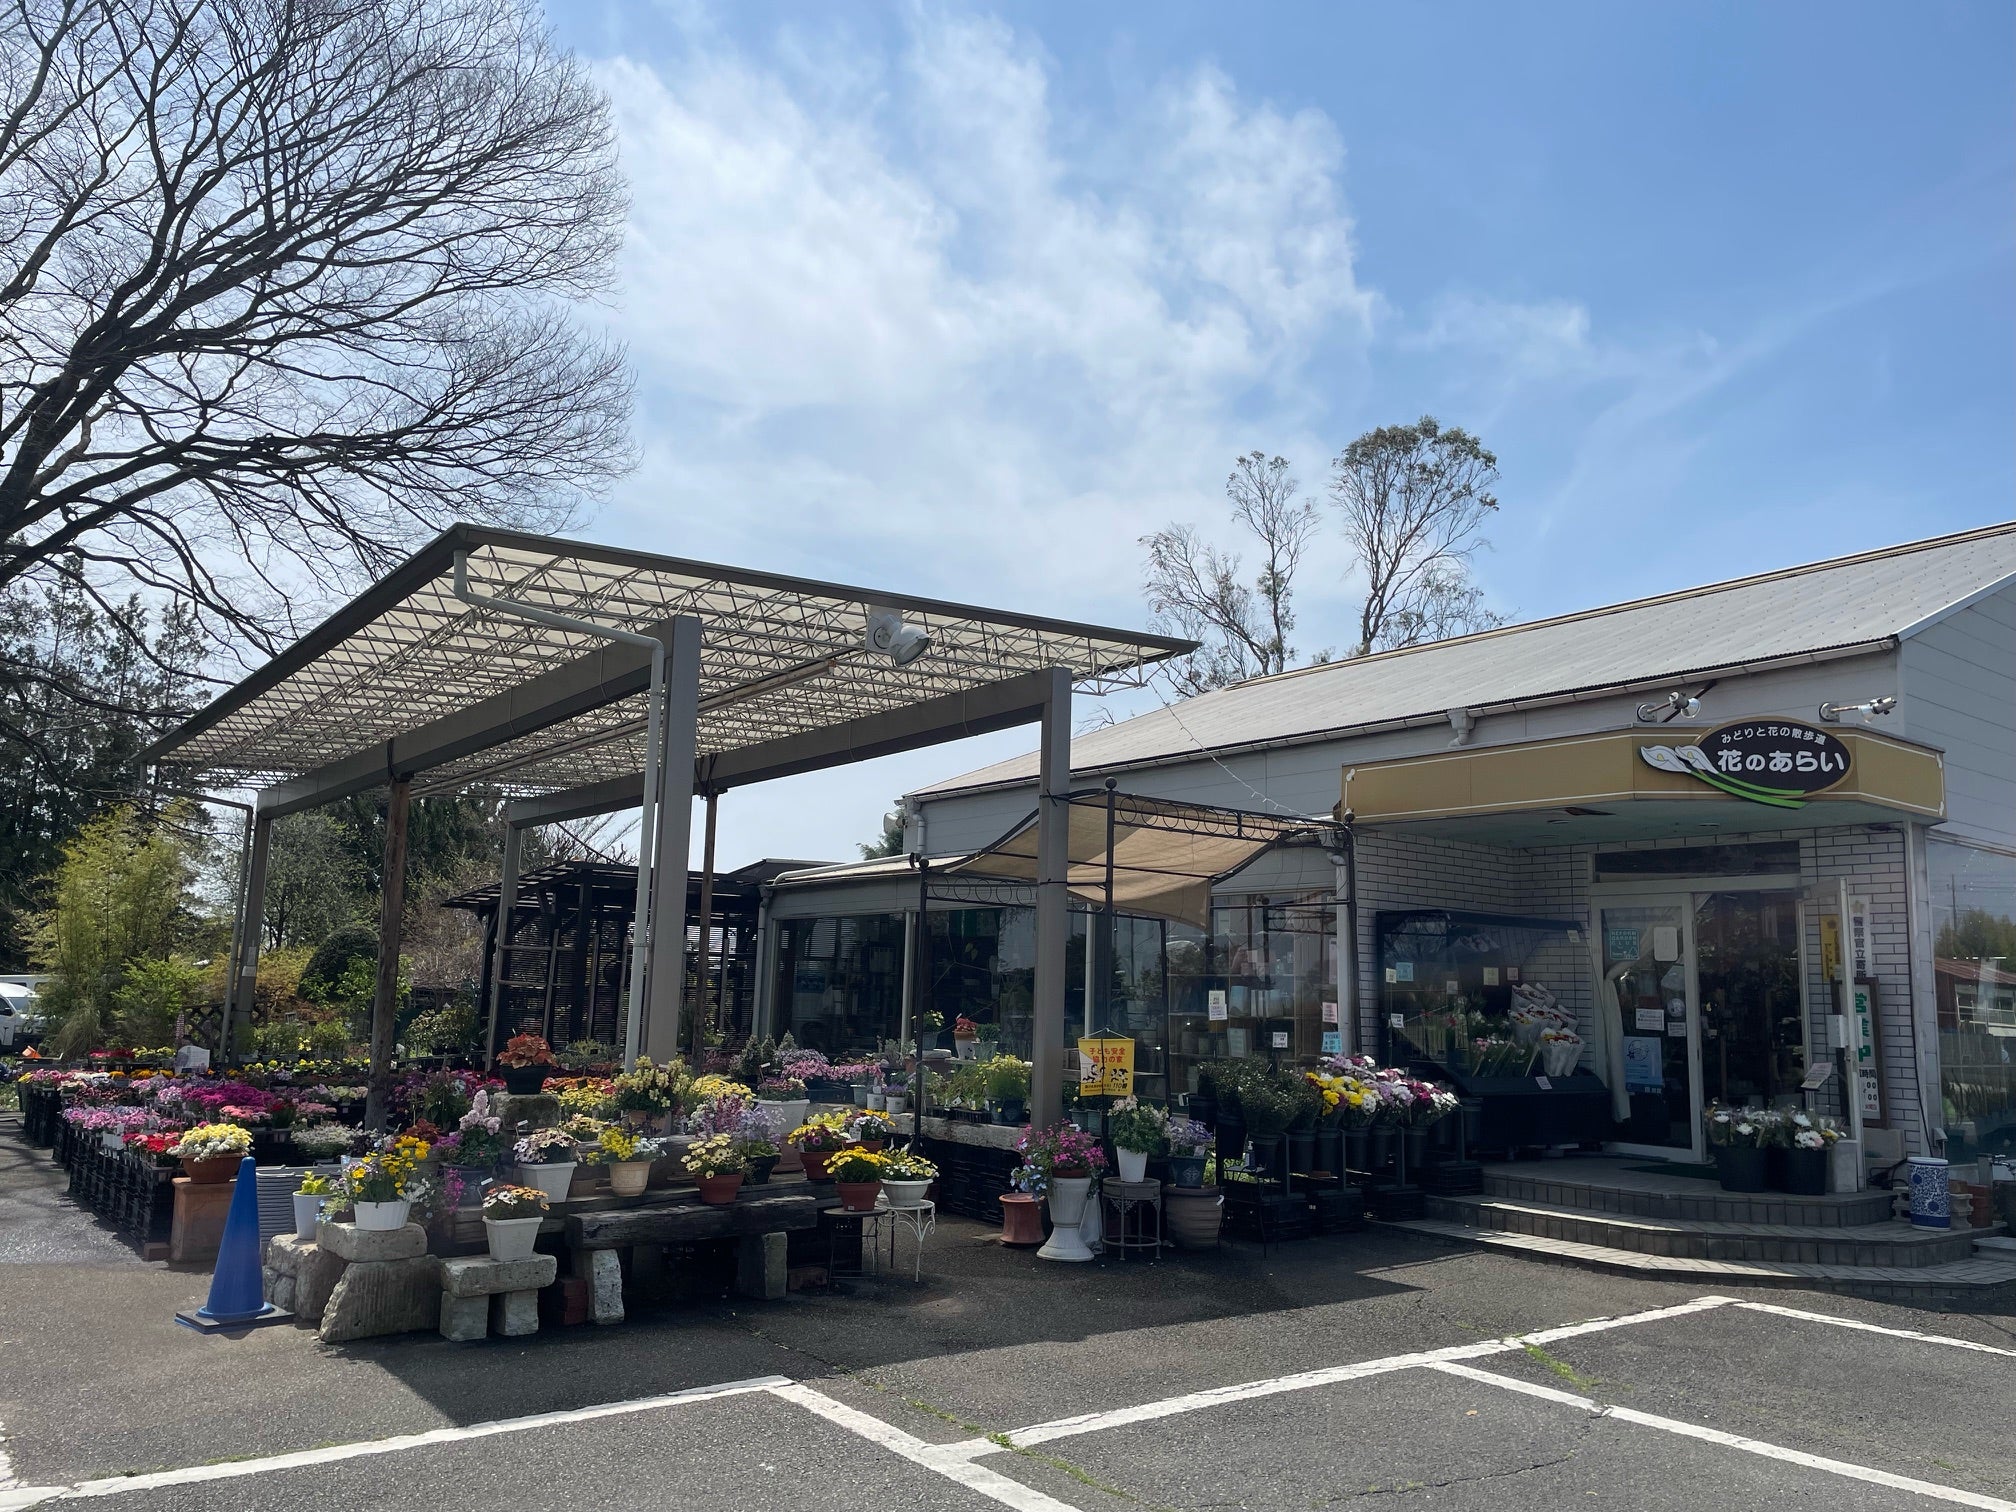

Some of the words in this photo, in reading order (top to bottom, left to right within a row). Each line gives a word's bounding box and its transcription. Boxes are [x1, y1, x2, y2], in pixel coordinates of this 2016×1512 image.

[1721, 726, 1826, 745] みどりと花の散歩道
[1717, 749, 1845, 773] 花のあらい
